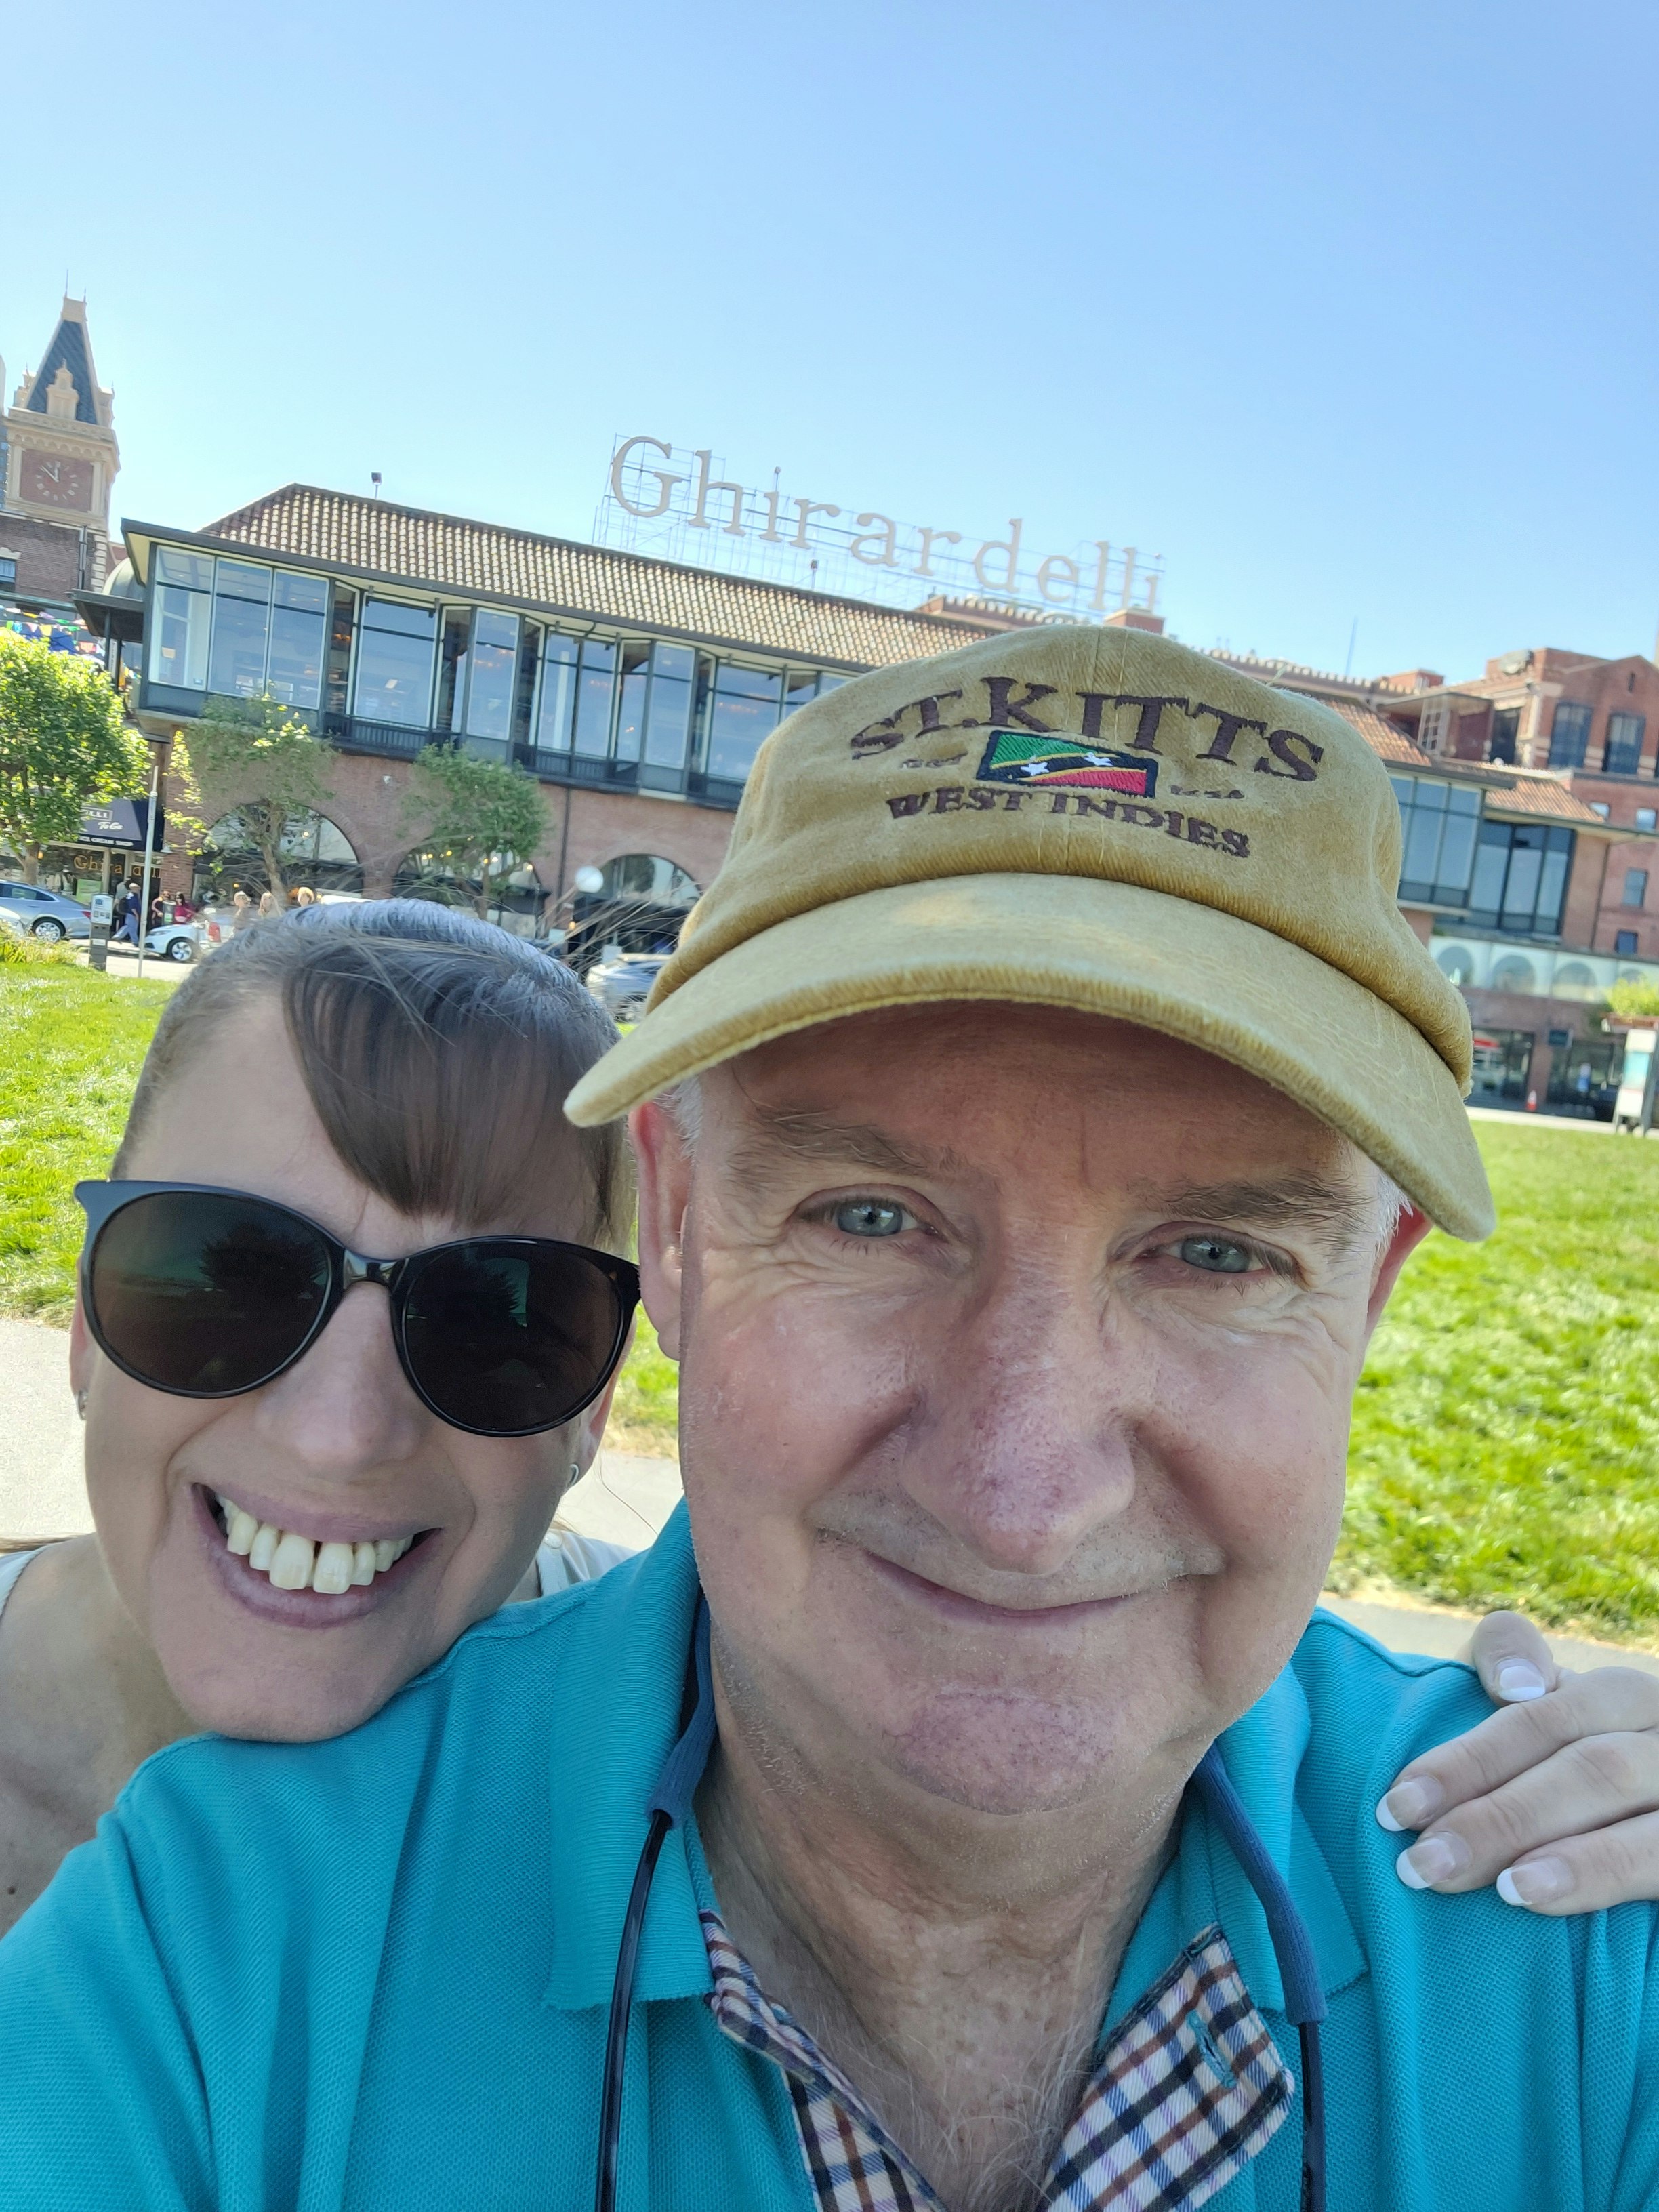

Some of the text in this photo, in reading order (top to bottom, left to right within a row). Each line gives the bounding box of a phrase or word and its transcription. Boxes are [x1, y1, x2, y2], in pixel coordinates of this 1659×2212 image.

[611, 436, 1160, 611] Ghirardelli
[981, 676, 1324, 781] KITTS
[886, 786, 1250, 858] WEST INDIES
